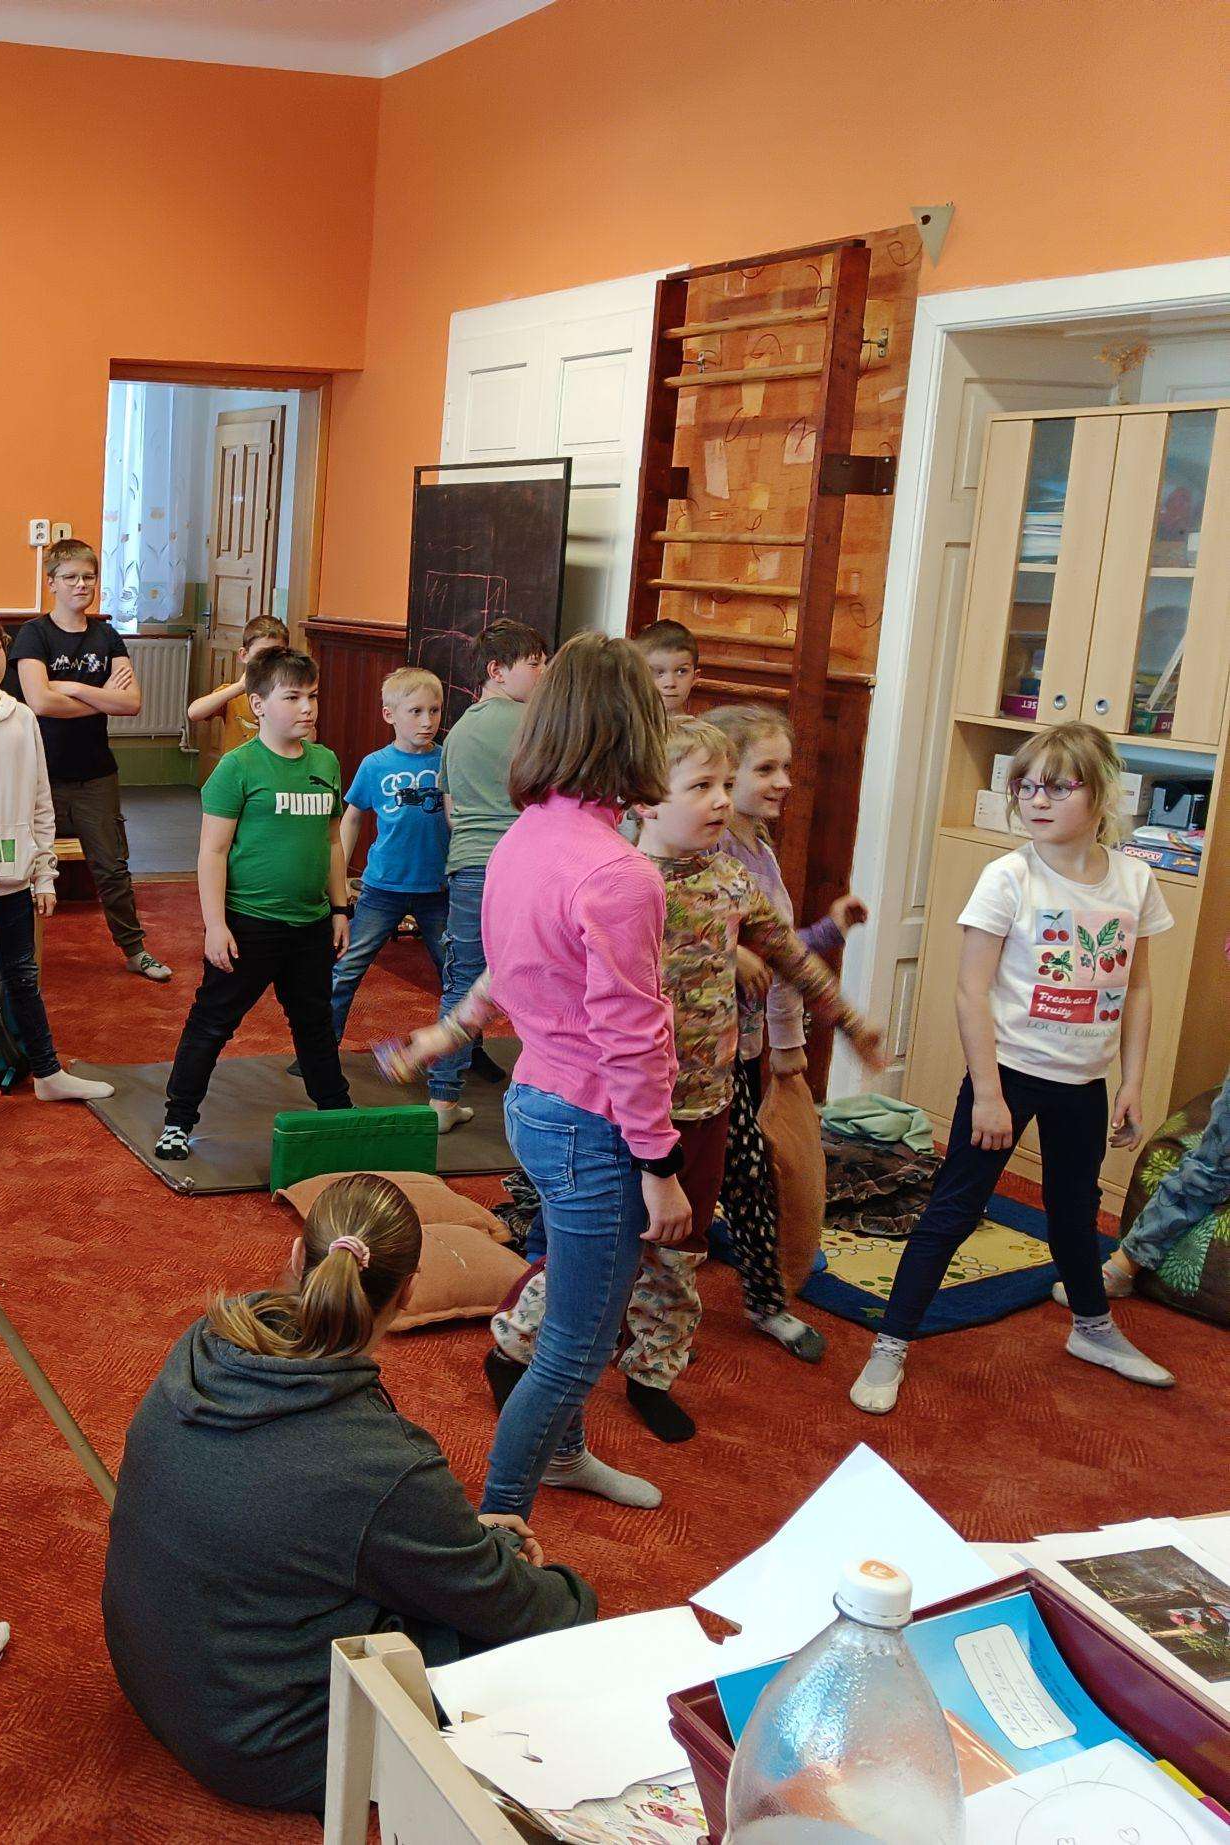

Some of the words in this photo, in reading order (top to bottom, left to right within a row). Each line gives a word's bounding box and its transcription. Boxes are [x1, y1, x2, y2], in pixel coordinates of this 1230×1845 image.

[275, 792, 334, 815] PUMA
[1123, 845, 1162, 862] MONOPOLY
[1038, 991, 1072, 1004] Fresh
[1072, 996, 1092, 1005] and
[1036, 1002, 1074, 1018] Fruity
